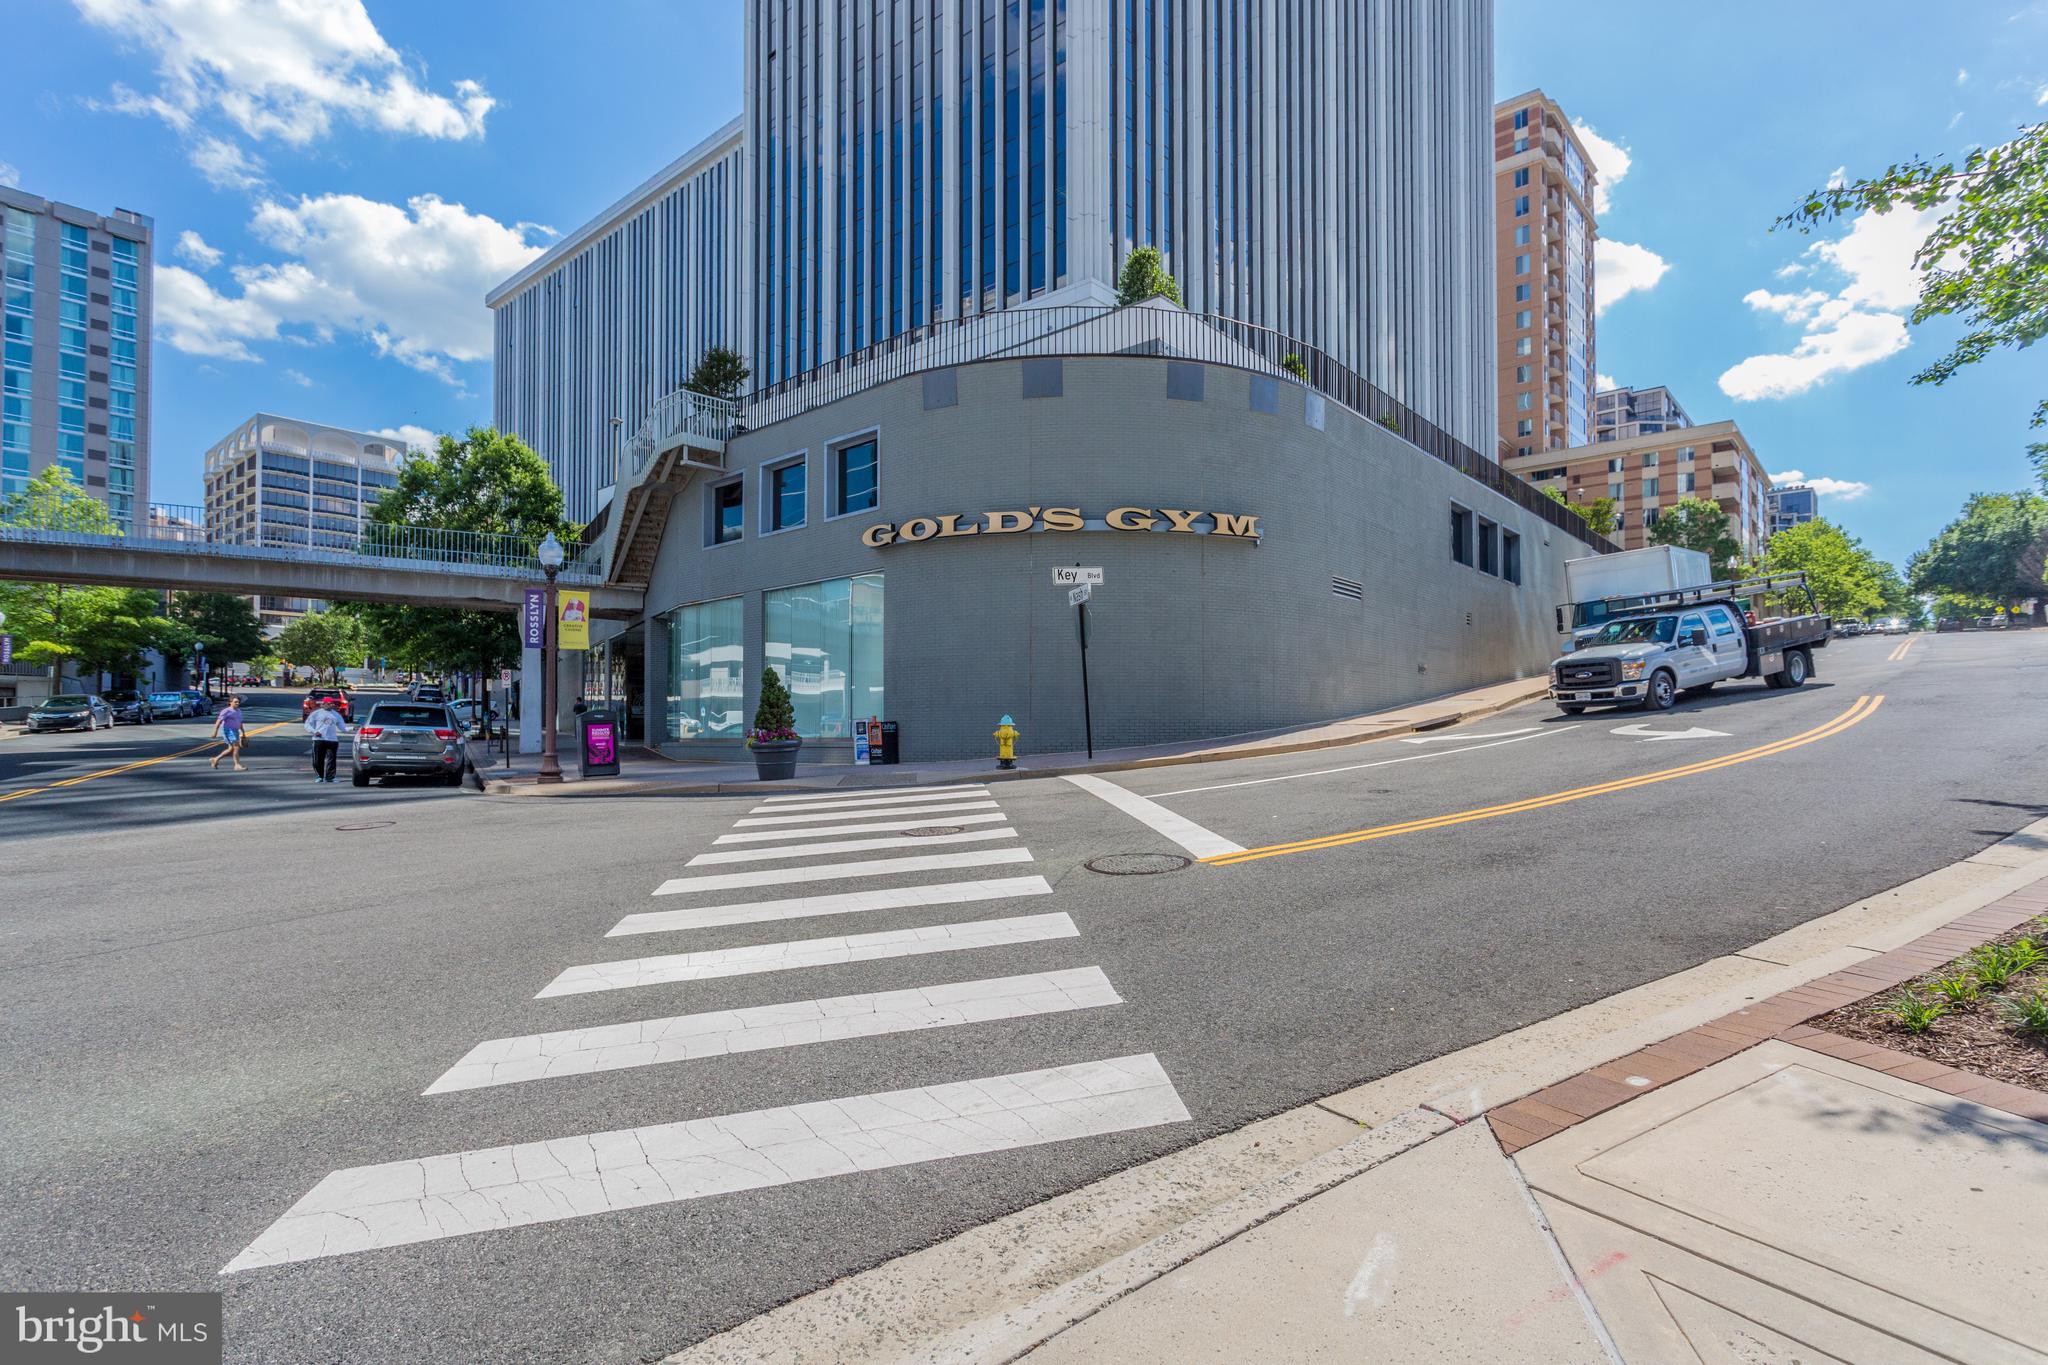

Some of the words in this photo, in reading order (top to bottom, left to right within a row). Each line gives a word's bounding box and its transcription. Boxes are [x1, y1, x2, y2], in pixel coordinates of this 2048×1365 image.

[861, 506, 1085, 547] GOLD'S
[1105, 506, 1261, 538] GYM
[1057, 569, 1078, 583] Key
[529, 594, 539, 644] ROSSLYN
